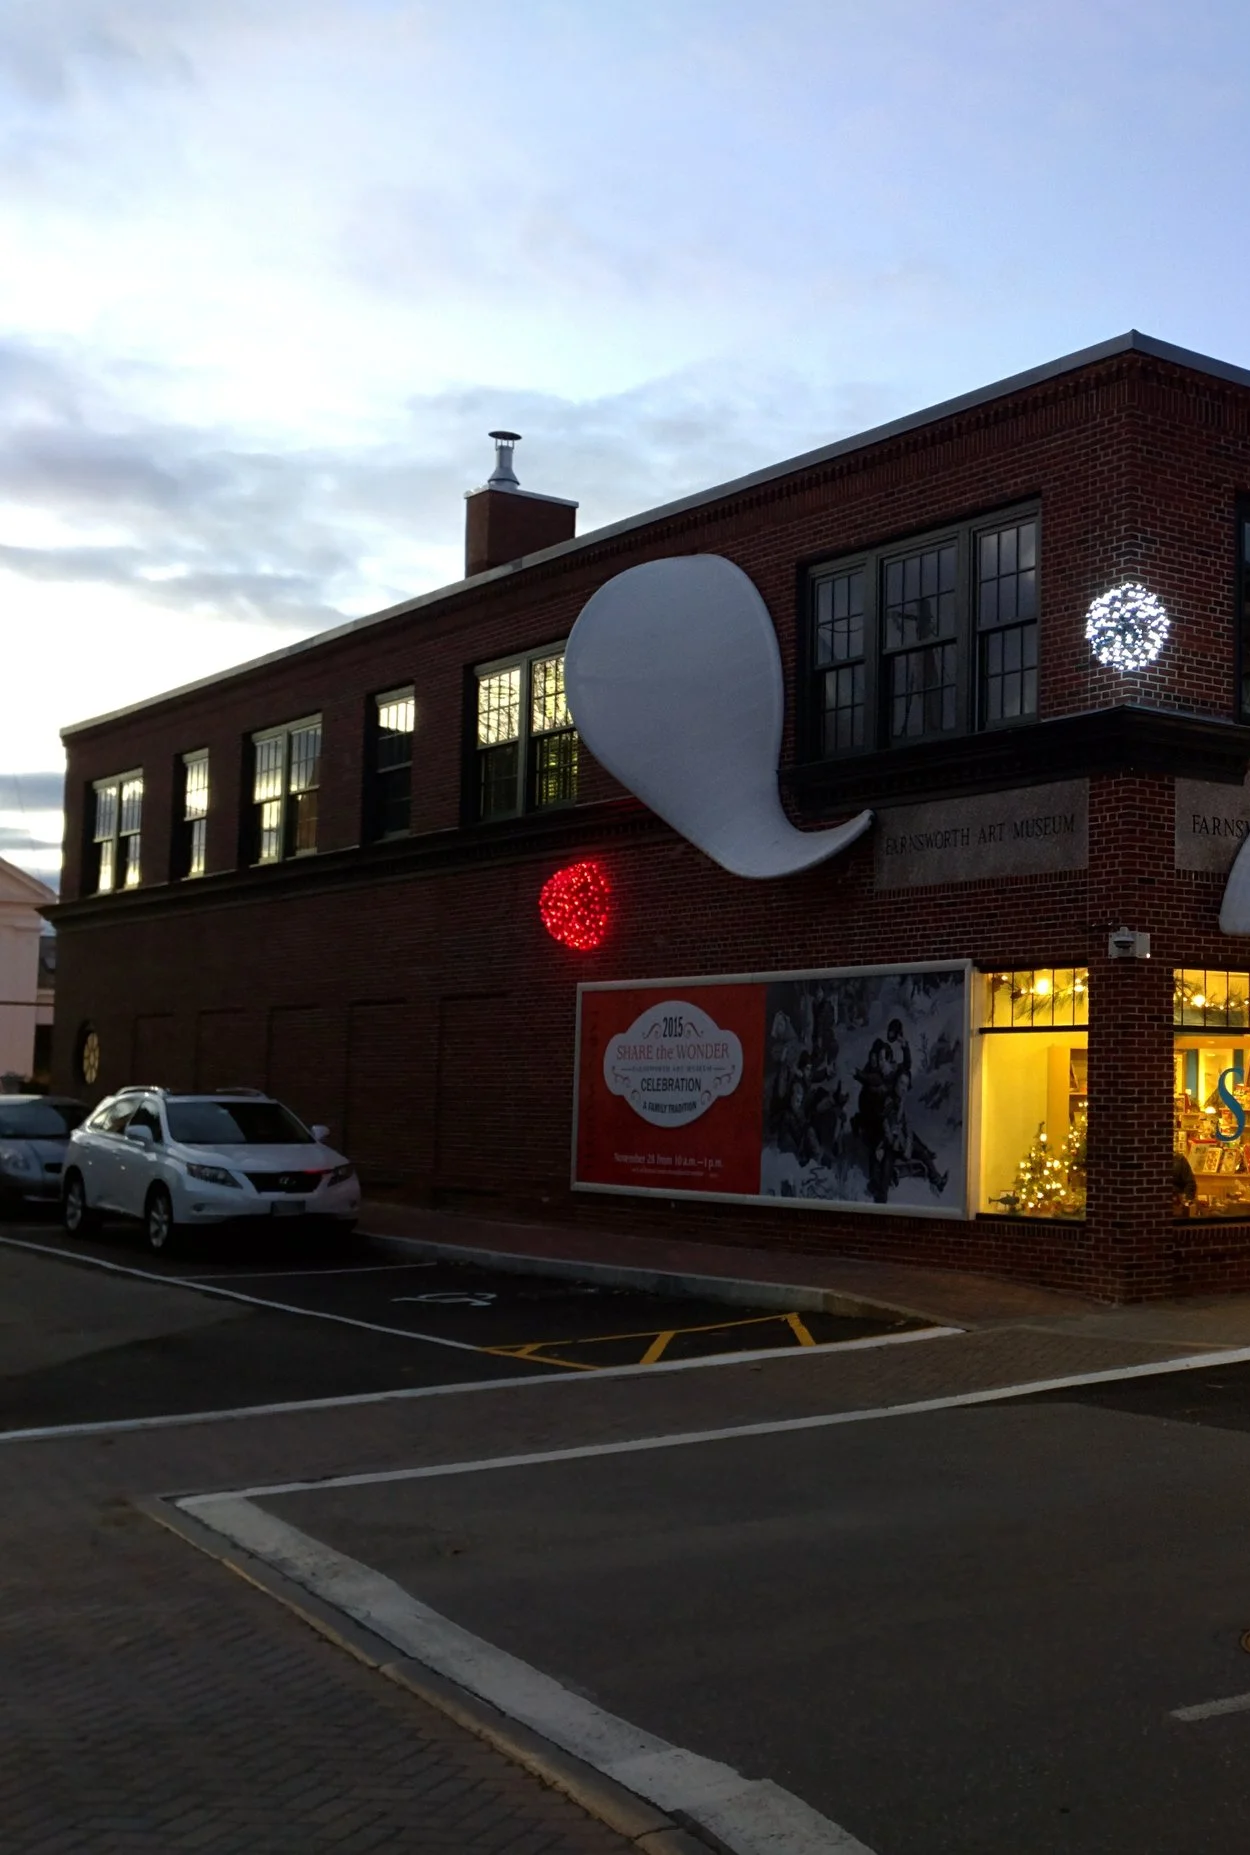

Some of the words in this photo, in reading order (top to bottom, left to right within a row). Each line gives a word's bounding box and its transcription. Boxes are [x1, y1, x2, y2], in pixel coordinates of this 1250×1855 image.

[886, 828, 970, 855] FARNSWORTH
[978, 823, 1006, 844] ART
[1013, 814, 1075, 839] MUSEUM
[662, 1016, 684, 1038] 2015
[616, 1044, 653, 1060] SHARE
[656, 1045, 674, 1060] the
[676, 1042, 730, 1060] WONDER
[640, 1078, 701, 1092] CELEBRATION
[648, 1102, 669, 1113] FAMILY
[668, 1101, 697, 1113] TRADITION
